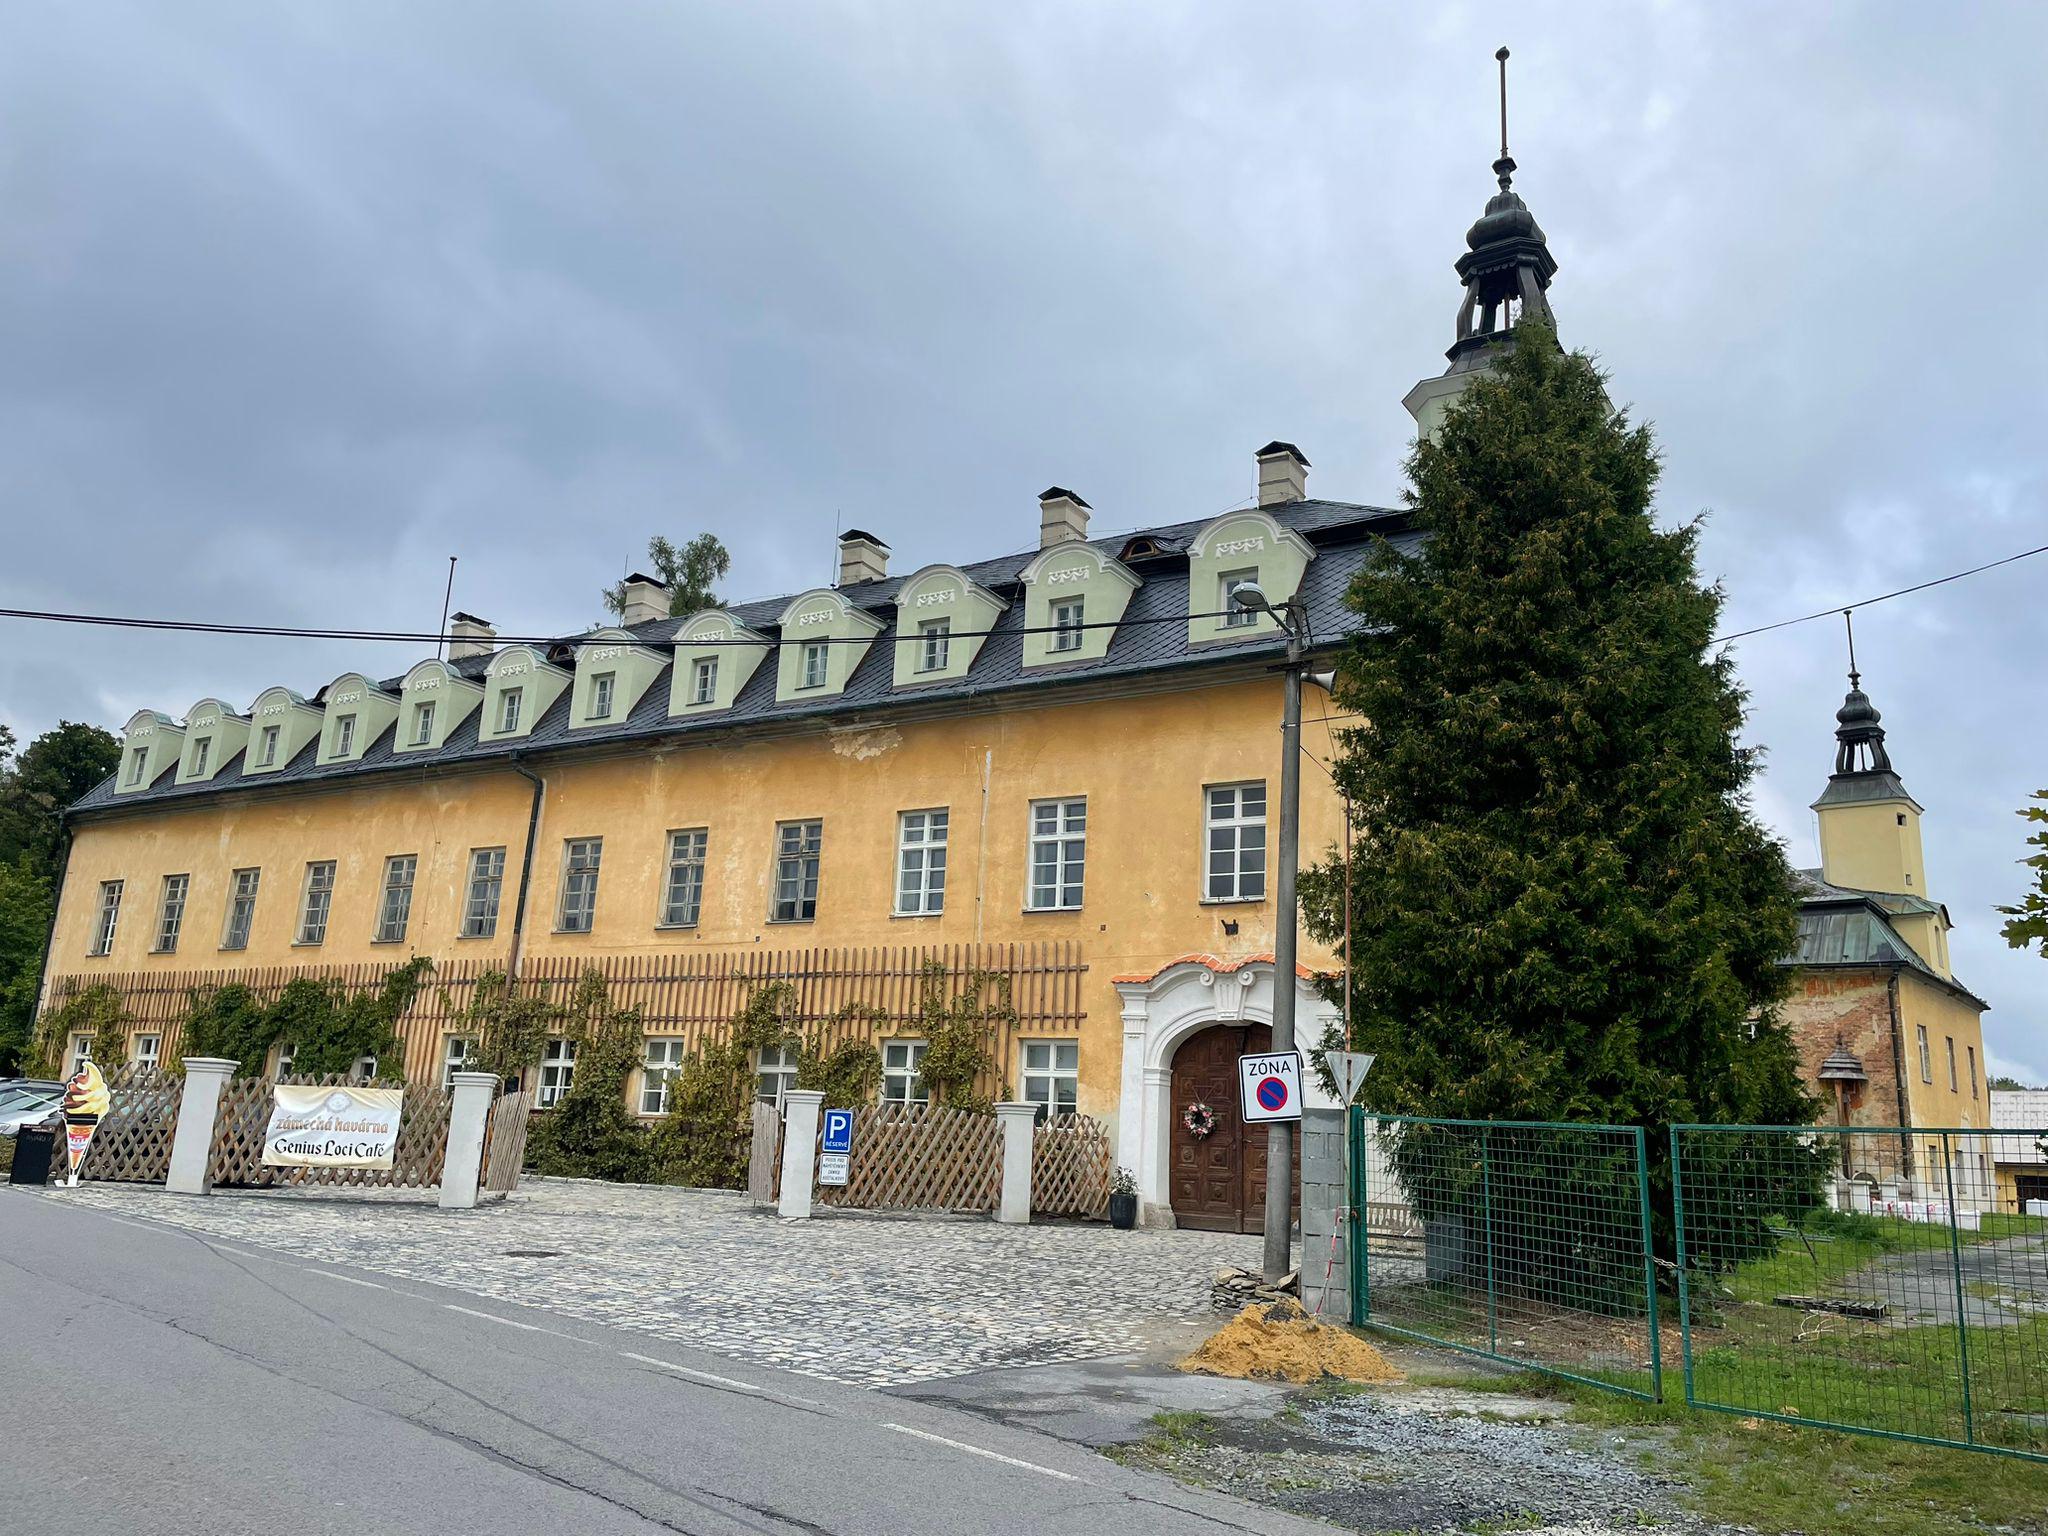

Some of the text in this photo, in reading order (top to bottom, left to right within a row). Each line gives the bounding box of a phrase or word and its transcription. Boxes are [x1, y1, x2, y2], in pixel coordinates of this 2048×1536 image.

[1249, 1059, 1291, 1076] ZÓNA
[829, 1115, 847, 1139] P
[274, 1138, 386, 1158] Genius Loci Café
